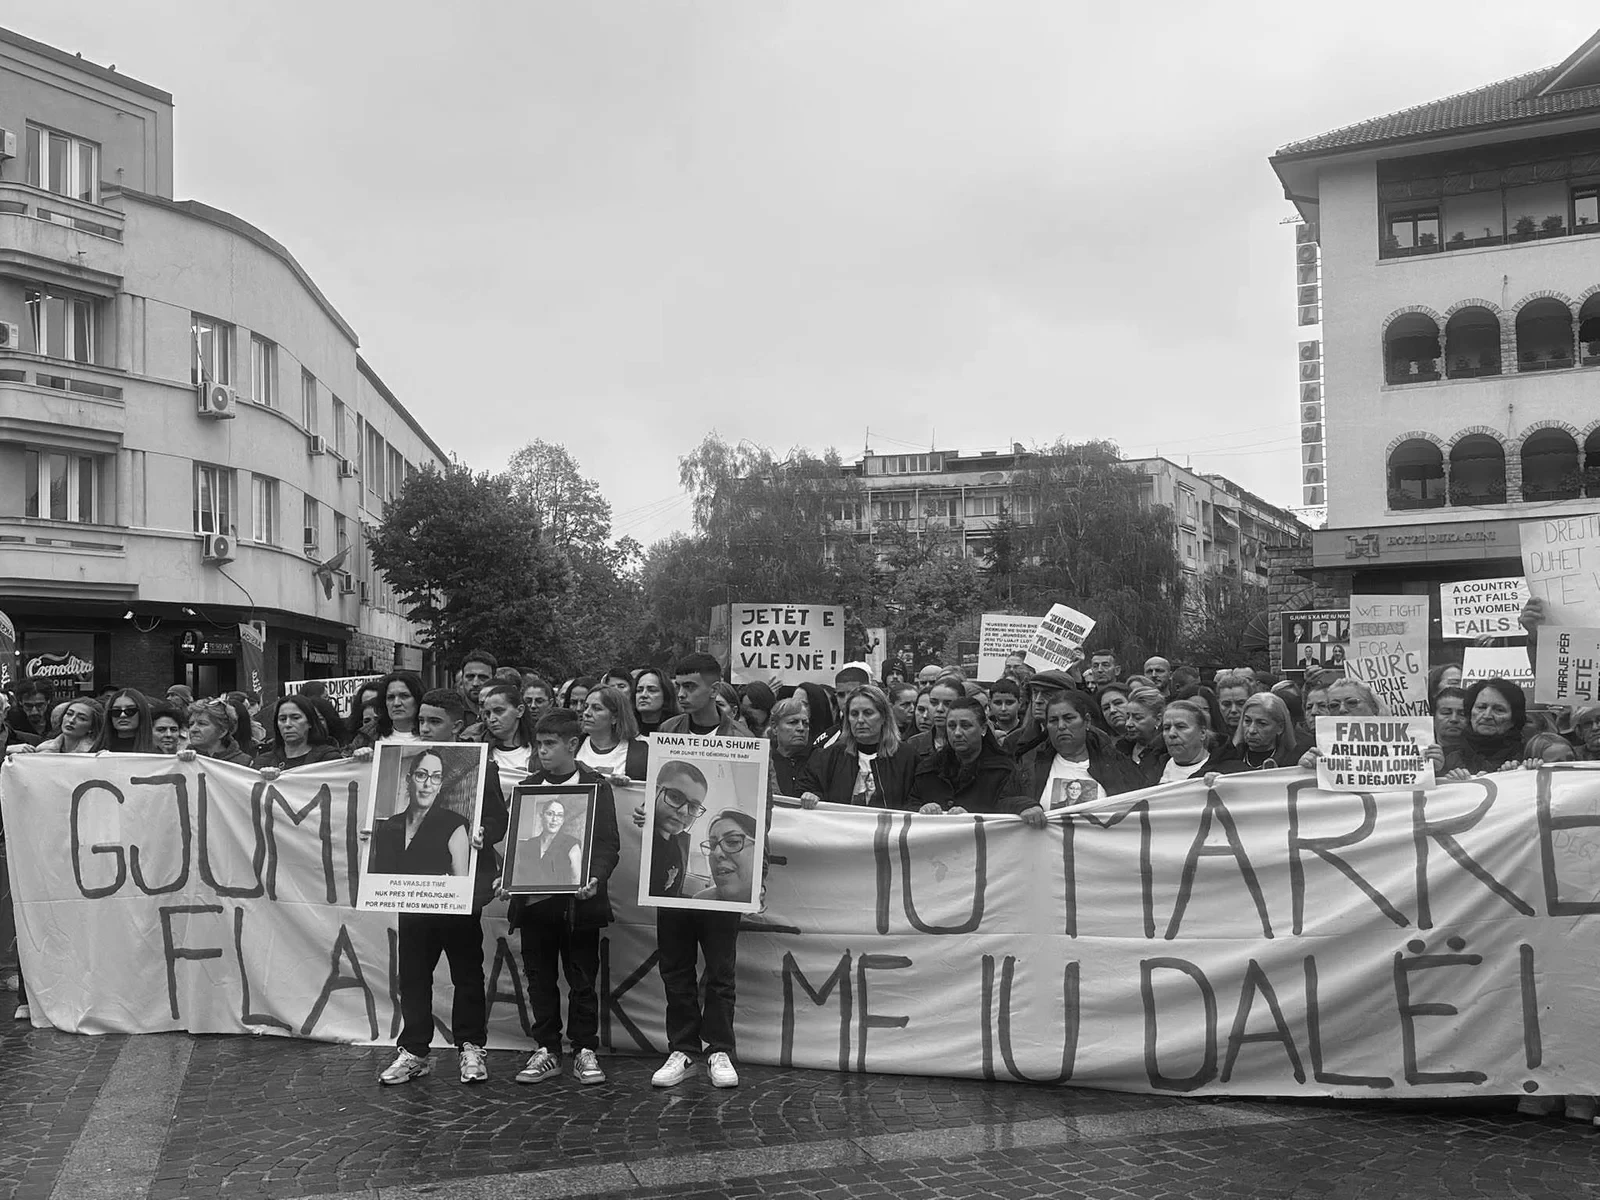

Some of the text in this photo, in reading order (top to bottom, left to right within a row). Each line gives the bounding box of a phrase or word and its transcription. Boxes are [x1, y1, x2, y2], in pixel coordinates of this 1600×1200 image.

[1298, 223, 1318, 325] HOTEL
[1530, 547, 1585, 573] DUHET
[1452, 581, 1519, 594] A COUNTRY
[1453, 592, 1518, 604] THAT FAILS
[741, 605, 835, 627] JETËT E
[1355, 604, 1425, 617] WE FIGHT
[1454, 603, 1520, 616] ITS WOMEN
[740, 629, 811, 647] GRAVE
[1358, 640, 1405, 656] FOR A
[1467, 668, 1475, 677] A
[1478, 668, 1486, 677] U
[1488, 668, 1510, 677] DHA
[1556, 633, 1570, 699] THIRRJE PËR
[1572, 658, 1592, 701] JETË
[1335, 722, 1416, 744] FARUK,
[657, 736, 761, 750] NANA TE DUA SHUME
[1331, 744, 1420, 757] ARLINDA THA
[1356, 759, 1383, 772] JAM
[1335, 772, 1417, 786] A E DËGJOVE?
[70, 773, 359, 908] GJUMI
